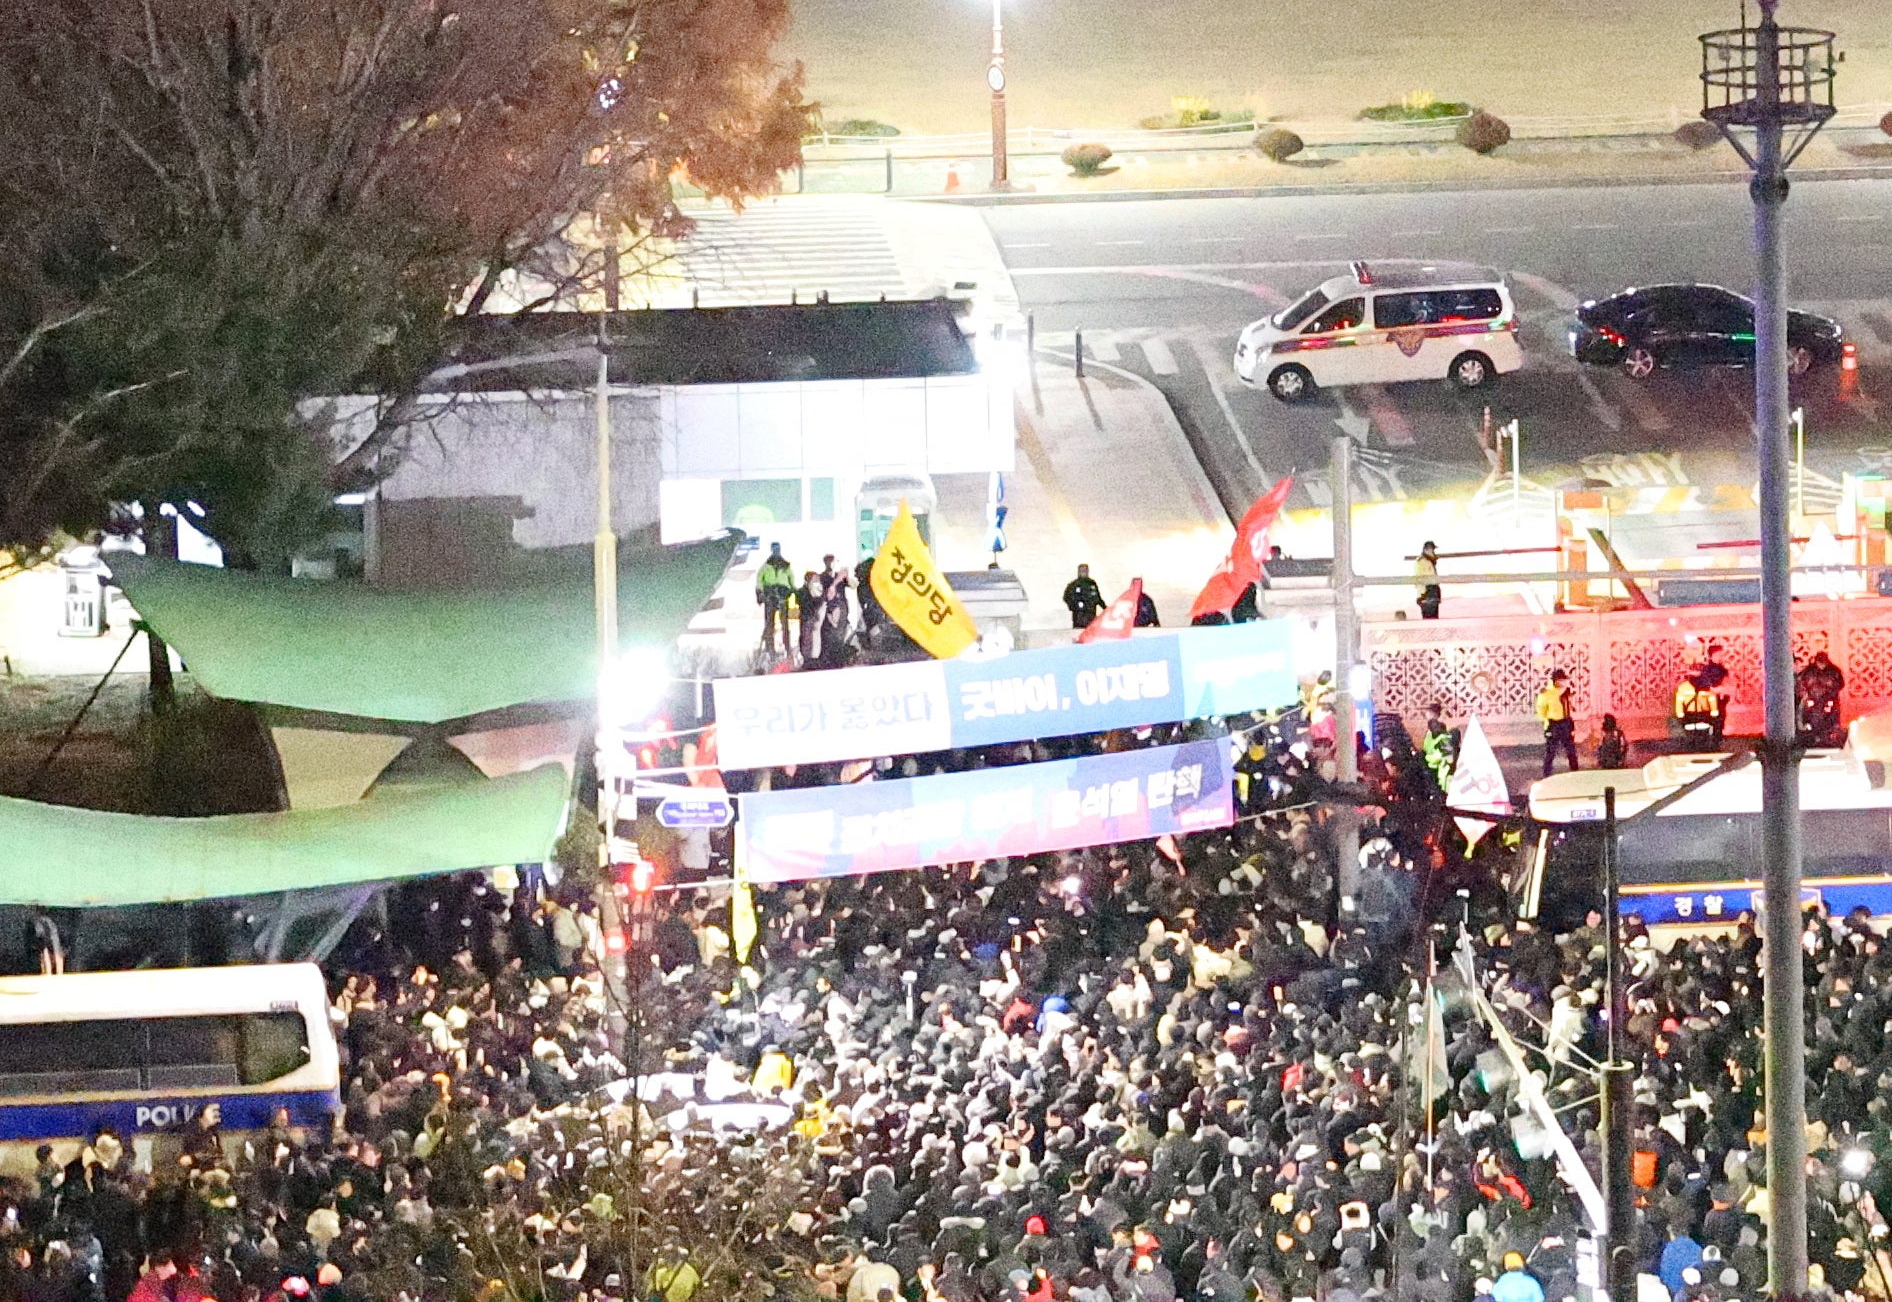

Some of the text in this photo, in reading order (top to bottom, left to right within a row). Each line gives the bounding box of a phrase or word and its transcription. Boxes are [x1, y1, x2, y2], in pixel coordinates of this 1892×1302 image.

[891, 546, 952, 625] 정의당
[733, 691, 934, 736] 우리가 옳았다
[1673, 895, 1724, 917] 경찰
[136, 1103, 222, 1127] POLIE
